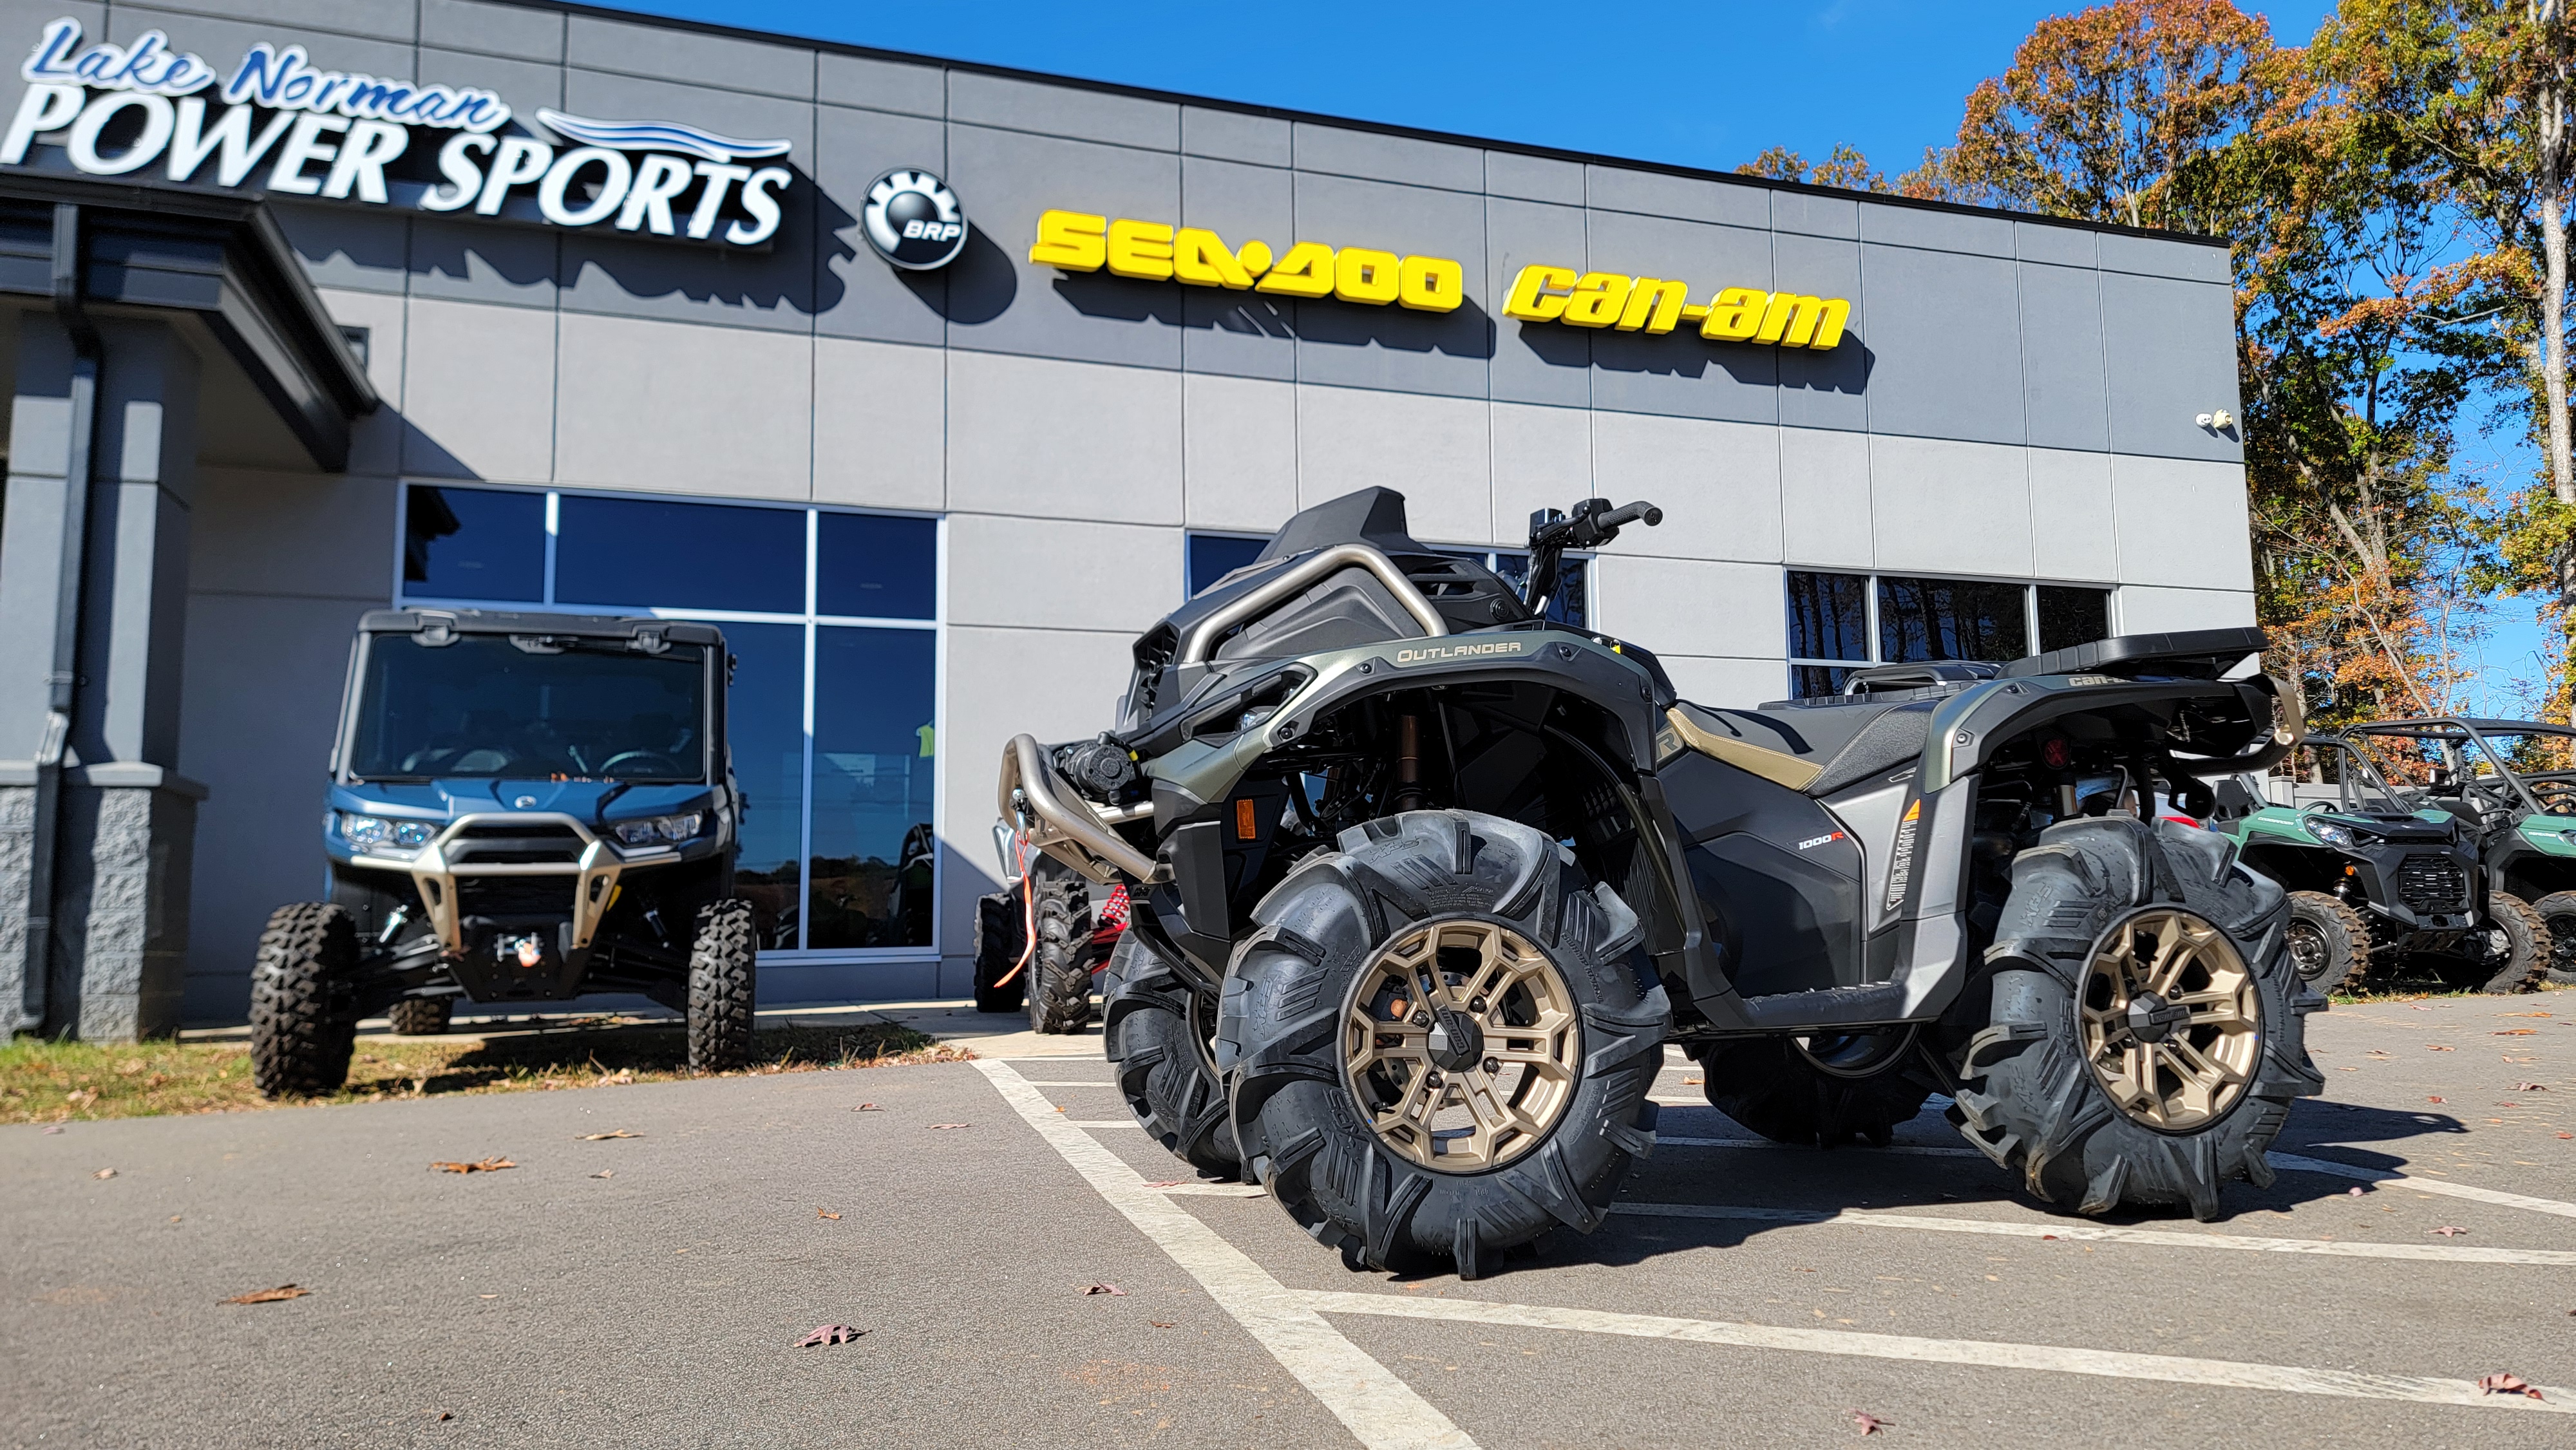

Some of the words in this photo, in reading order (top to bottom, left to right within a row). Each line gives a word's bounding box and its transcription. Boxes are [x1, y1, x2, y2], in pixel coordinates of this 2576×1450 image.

[24, 18, 214, 95] Lake
[223, 42, 509, 131] Norman
[0, 82, 408, 203] POWER
[419, 131, 792, 245] SPORTS
[902, 219, 962, 241] BRP
[1502, 264, 1850, 351] can-am
[1397, 642, 1521, 663] OUTLANDER
[2068, 676, 2132, 686] can-
[1798, 831, 1844, 850] 1000R
[1439, 1008, 1466, 1050] can-am
